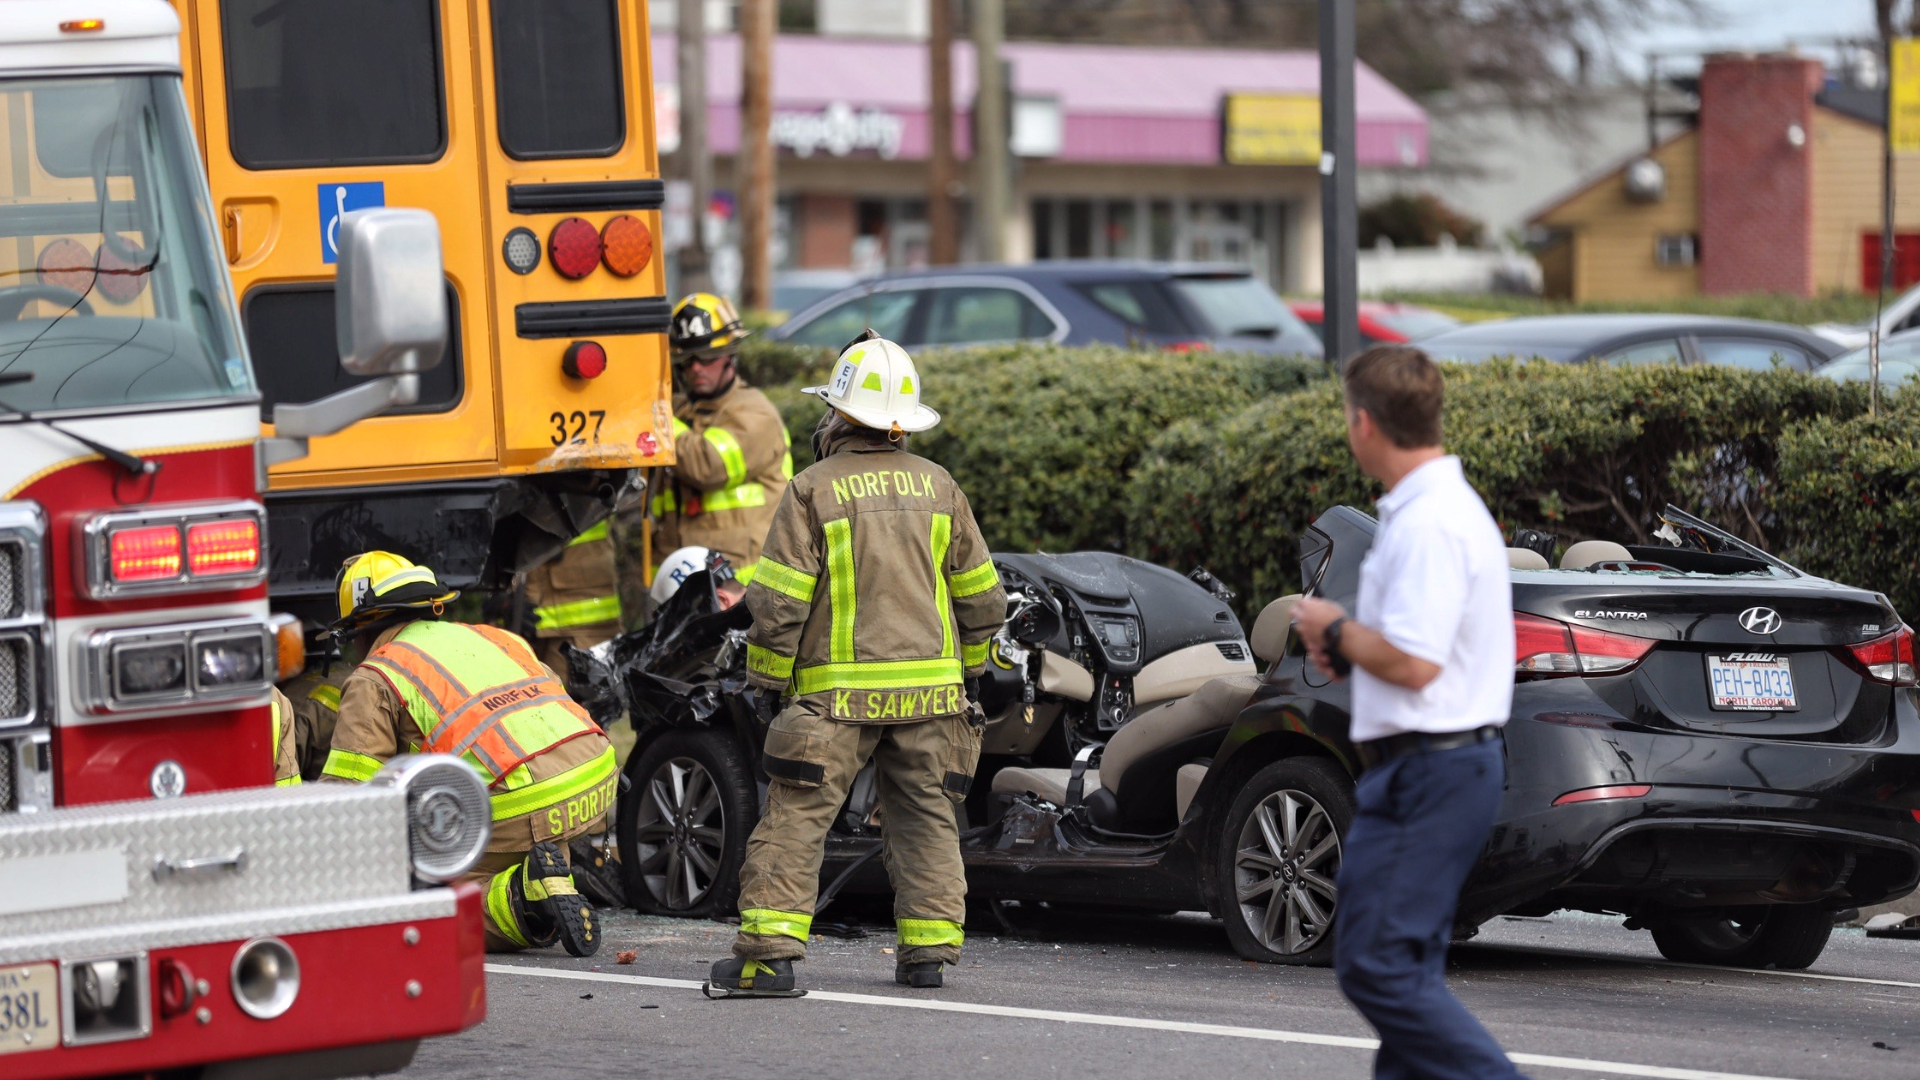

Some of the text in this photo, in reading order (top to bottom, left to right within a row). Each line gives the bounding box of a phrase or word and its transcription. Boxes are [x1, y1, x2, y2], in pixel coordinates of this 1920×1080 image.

[680, 315, 706, 339] 14
[842, 365, 851, 377] E
[837, 378, 846, 390] 11
[550, 410, 606, 447] 327
[831, 470, 936, 505] NORFOLK
[358, 581, 364, 591] L
[670, 560, 697, 587] R1
[1574, 610, 1648, 620] ELANTRA
[1727, 652, 1775, 662] FLOW
[1713, 668, 1792, 697] PEH-8433
[483, 684, 544, 711] NORFLK
[835, 685, 959, 719] K. SAWYER
[1719, 697, 1748, 706] NORTH
[548, 808, 563, 835] S
